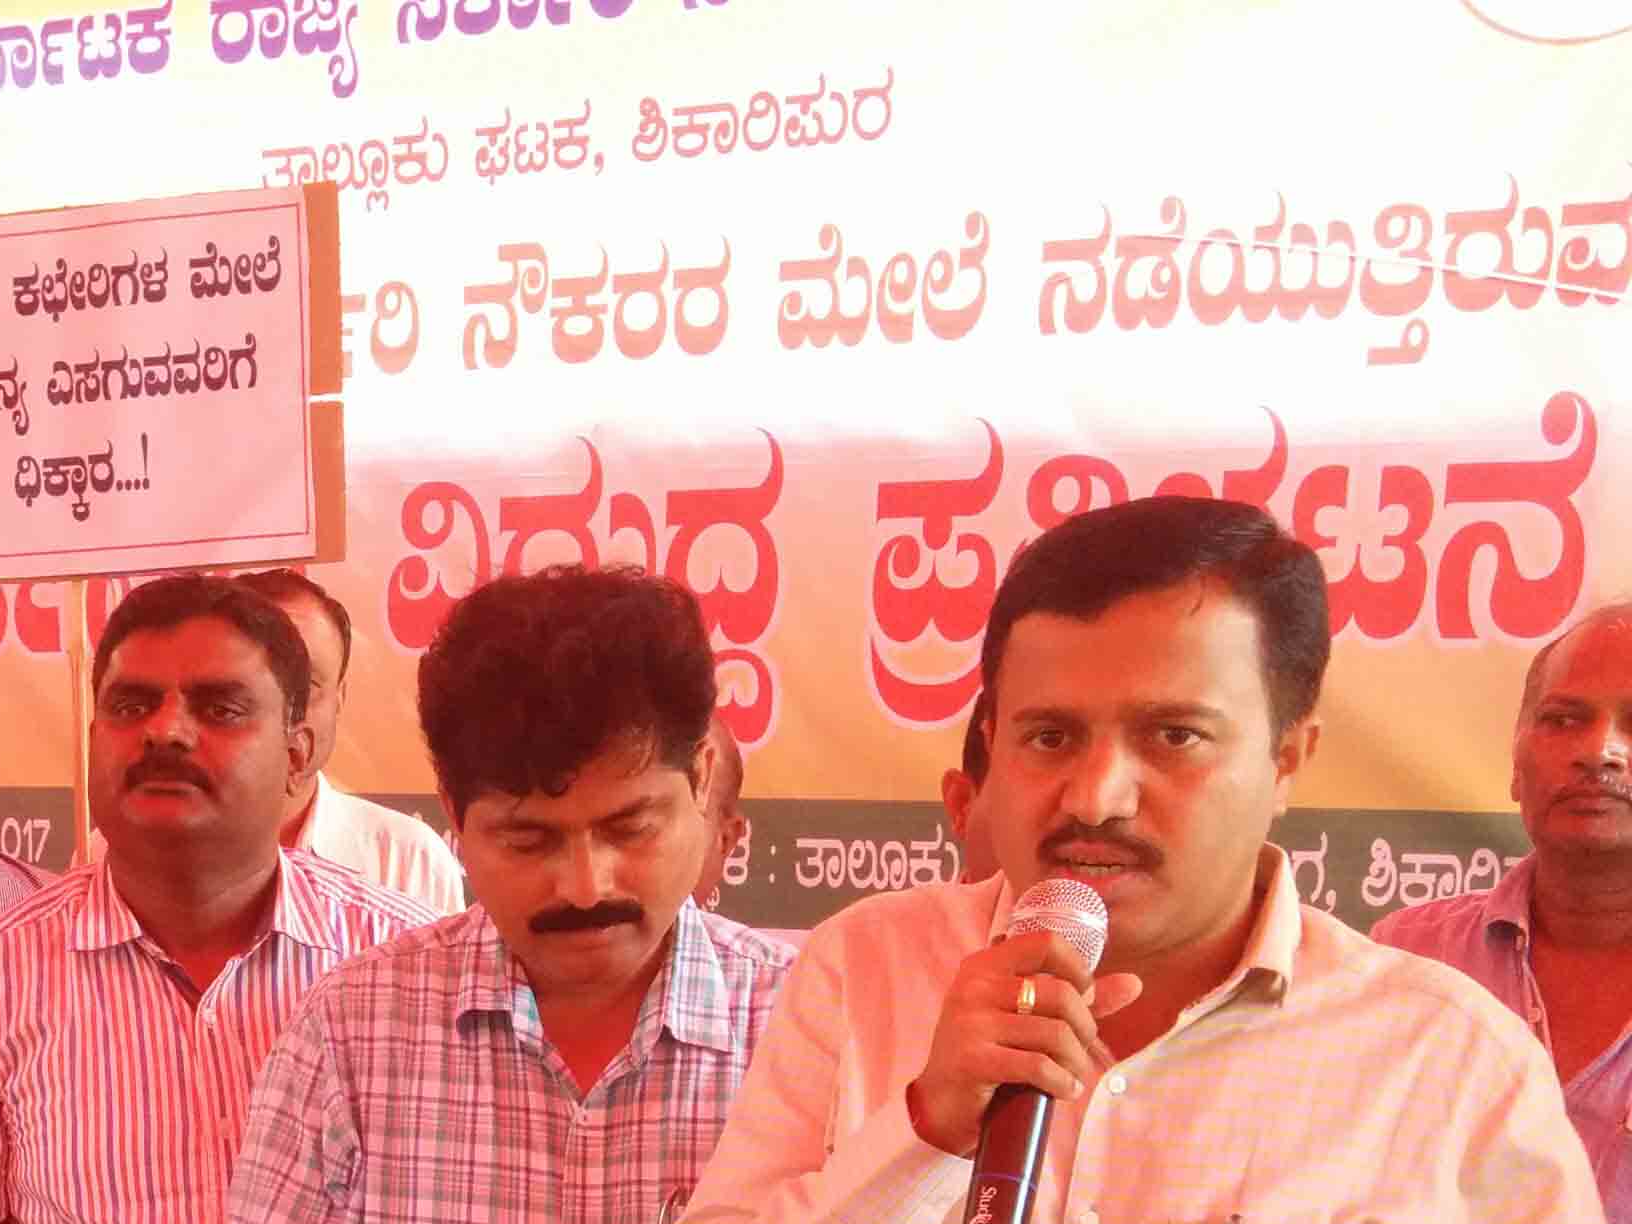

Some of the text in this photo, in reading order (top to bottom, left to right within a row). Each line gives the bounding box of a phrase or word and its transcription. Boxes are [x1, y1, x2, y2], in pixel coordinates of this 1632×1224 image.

[632, 66, 894, 162] ಶಿಕಾರಿಪುರ
[189, 235, 281, 299] ಮೇಲೆ
[462, 234, 731, 371] ನೌಕರರ
[778, 210, 990, 350] ಮೇಲೆ
[47, 332, 258, 406] ಎಸಗುವವರಿಗೆ
